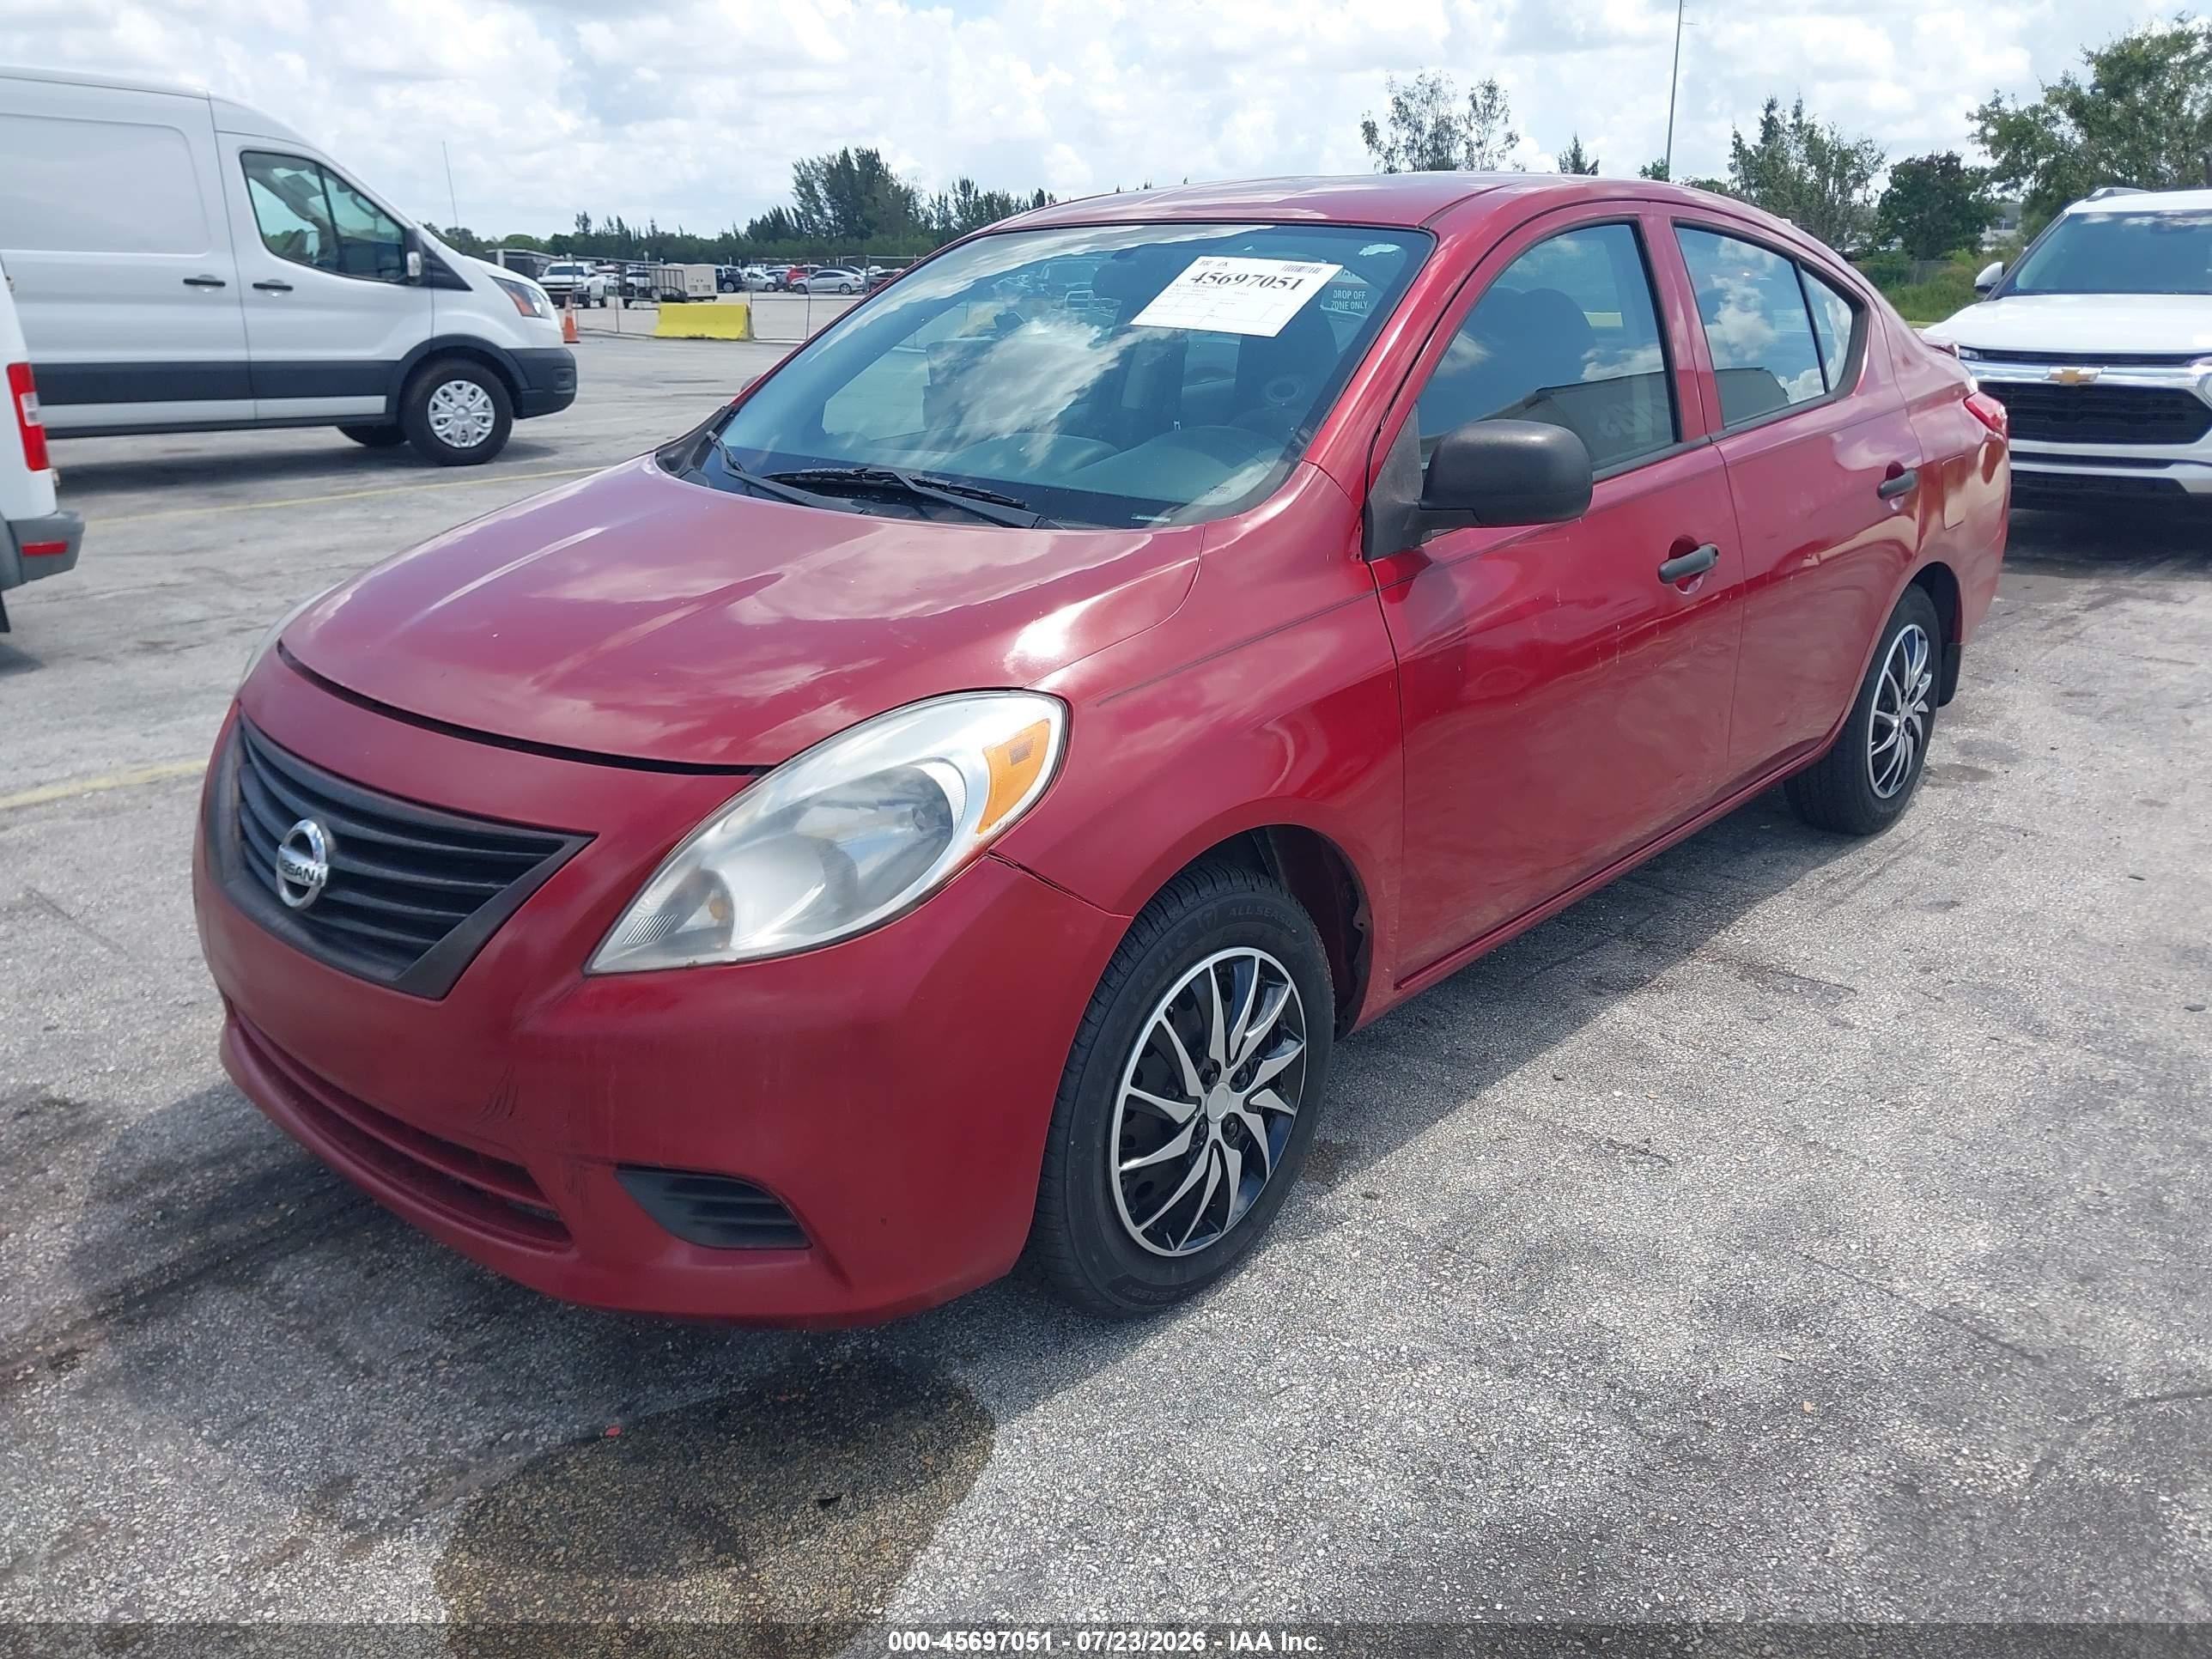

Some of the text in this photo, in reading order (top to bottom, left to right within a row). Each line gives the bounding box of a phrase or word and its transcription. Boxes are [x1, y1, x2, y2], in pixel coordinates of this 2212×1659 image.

[1189, 270, 1305, 290] 45697051
[1333, 289, 1366, 300] DROP OFF
[1331, 301, 1368, 310] ZONE ONLY
[1255, 906, 1294, 930] SEASO
